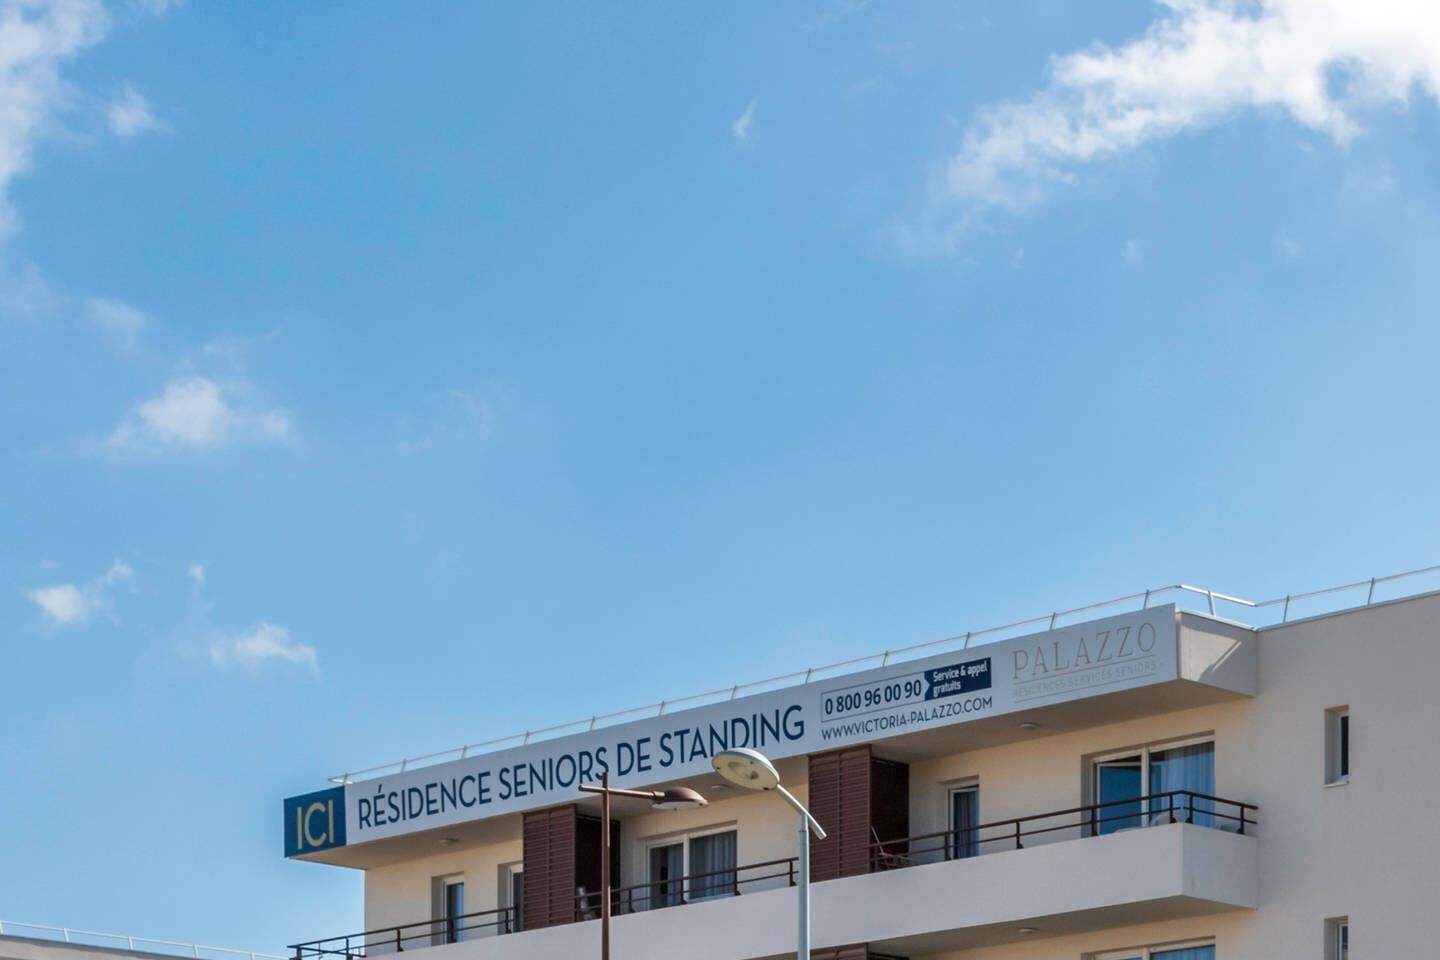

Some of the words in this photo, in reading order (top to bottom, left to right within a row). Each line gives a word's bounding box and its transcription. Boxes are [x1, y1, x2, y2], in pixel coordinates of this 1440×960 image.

[932, 670, 960, 683] Service
[967, 660, 989, 677] appel
[1013, 621, 1158, 679] PALAZZO
[821, 695, 993, 741] WWW.VICTORIA-PALAZZO.COM
[825, 698, 833, 715] 0
[836, 692, 862, 713] 800
[864, 688, 882, 707] 96
[884, 683, 901, 703] 00
[904, 679, 923, 698] 90
[358, 770, 492, 830] RÉSIDENCE
[498, 746, 609, 801] SENIORS
[617, 737, 652, 777] DE
[660, 704, 806, 764] STANDING
[296, 800, 335, 849] ICI
